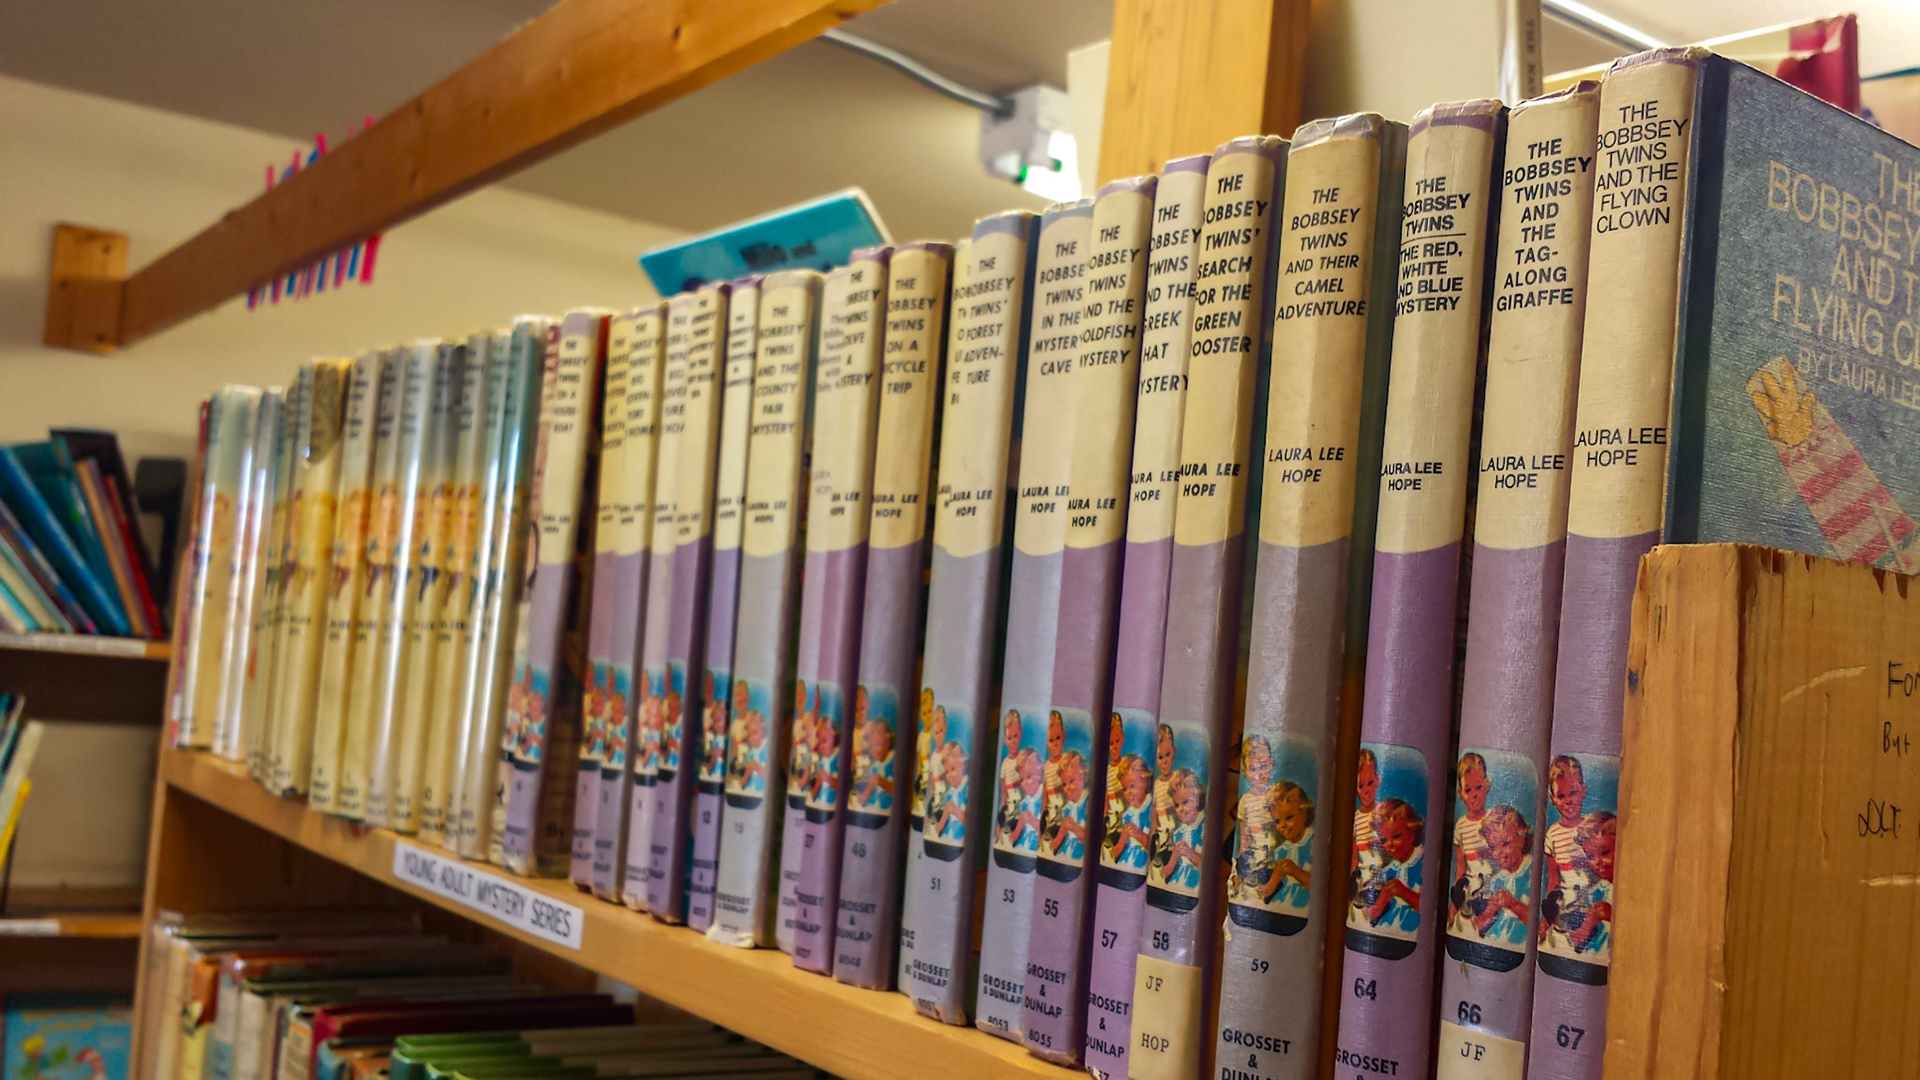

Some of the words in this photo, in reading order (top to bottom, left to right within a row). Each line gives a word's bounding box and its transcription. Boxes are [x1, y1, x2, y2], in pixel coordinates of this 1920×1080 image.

[1619, 100, 1658, 124] THE
[1597, 118, 1688, 151] BOBBSEY
[1528, 138, 1562, 159] THE
[1606, 142, 1667, 168] TWINS
[1504, 156, 1592, 186] BOBBSEY
[1596, 167, 1632, 192] AND
[1637, 162, 1678, 183] THE
[1217, 174, 1244, 195] THE
[1416, 177, 1446, 195] THE
[1514, 179, 1572, 204] TWINS
[1313, 187, 1340, 204] THE
[1601, 185, 1668, 212] FLYING
[1158, 204, 1180, 223] THE
[1292, 207, 1361, 231] BOBBSEY
[1521, 202, 1559, 223] AND
[1597, 206, 1670, 233] CLOWN
[1100, 225, 1120, 243] THE
[1405, 215, 1455, 237] TWINS
[1521, 223, 1556, 243] THE
[1150, 228, 1202, 252] OBBSEY
[1205, 228, 1260, 251] TWINS'
[1300, 232, 1348, 251] TWINS
[1056, 242, 1077, 257] THE
[1088, 248, 1140, 270] OBBSEY
[1400, 245, 1419, 265] THE
[1422, 241, 1462, 259] RED,
[1515, 245, 1558, 265] TAG-
[979, 256, 996, 273] THE
[1040, 264, 1085, 284] BOBBSE
[1149, 256, 1188, 278] TWINS
[1197, 256, 1252, 280] SEARCH
[1285, 258, 1313, 275] AND
[1319, 254, 1359, 270] THEIR
[1402, 261, 1448, 280] WHITE
[1089, 274, 1126, 294] TWINS
[1503, 266, 1567, 289] ALONG
[1831, 243, 1896, 306] AND
[896, 278, 916, 291] THE
[1167, 282, 1196, 299] THE
[1295, 278, 1344, 296] CAMEL
[1397, 282, 1414, 299] ND
[1418, 277, 1464, 293] BLUE
[1045, 287, 1083, 306] TWINS
[1196, 290, 1215, 307] OR
[1222, 284, 1252, 301] THE
[1497, 288, 1573, 312] GIRAFFE
[773, 306, 788, 318] THE
[888, 298, 936, 313] OBBSEY
[1083, 301, 1102, 319] ND
[1108, 299, 1134, 314] THE
[1276, 300, 1367, 321] ADVENTURE
[1773, 272, 1884, 357] FLYING
[889, 318, 924, 331] TWINS
[1042, 314, 1053, 330] IN
[1059, 311, 1080, 326] THE
[1194, 311, 1242, 332] GREEN
[966, 324, 1003, 342] FOREST
[1083, 325, 1136, 344] OLDFISH
[765, 344, 794, 356] TWINS
[909, 340, 918, 351] A
[1034, 335, 1082, 354] MYSTER
[1143, 343, 1168, 363] HAT
[1190, 336, 1251, 357] OOSTER
[1041, 359, 1072, 376] CAVE
[1080, 350, 1131, 368] YSTERY
[758, 365, 776, 377] AND
[781, 363, 799, 374] THE
[967, 370, 990, 385] TURE
[1799, 346, 1826, 378] BY
[1828, 354, 1888, 401] LAURA
[887, 382, 912, 395] TRIP
[1140, 374, 1188, 395] YSTERY
[763, 404, 783, 414] FAIR
[1628, 428, 1667, 445] LEE
[1269, 448, 1312, 463] LAURA
[1319, 447, 1345, 461] LEE
[1480, 456, 1526, 472] LAURA
[1532, 455, 1565, 470] LEE
[1587, 449, 1637, 467] HOPE
[1160, 471, 1180, 483] LEE
[1180, 463, 1207, 477] AURA
[1216, 463, 1240, 477] LEE
[1282, 469, 1322, 483] HOPE
[1415, 462, 1443, 475] LEE
[1183, 483, 1216, 497] HOPE
[1388, 478, 1422, 491] HOPE
[1494, 473, 1538, 489] HOPE
[901, 494, 919, 504] LEE
[976, 489, 992, 500] LEE
[1022, 486, 1049, 498] LAURA
[1134, 489, 1160, 502] HOPE
[876, 509, 901, 518] HOPE
[956, 506, 976, 517] HOPE
[1031, 502, 1056, 513] HOPE
[1097, 498, 1116, 510] LEE
[1072, 516, 1097, 527] HOPE
[931, 878, 941, 890] 51
[1003, 889, 1015, 903] 53
[477, 879, 527, 918] MYSTERY
[531, 897, 571, 938] SERIES
[1044, 898, 1059, 918] 55
[1101, 929, 1118, 949] 57
[1153, 930, 1170, 951] 58
[913, 959, 950, 978] GROSSET
[1027, 962, 1066, 985] GROSSET
[1251, 958, 1269, 974] 59
[983, 974, 1024, 994] GROSSET
[1146, 975, 1163, 992] JF
[1354, 977, 1377, 1000] 64
[989, 987, 1022, 1005] DUNLAP
[1025, 996, 1062, 1018] DUNLAP
[1458, 1001, 1482, 1025] 66
[1099, 1017, 1106, 1031] &
[1029, 1029, 1052, 1048] 8055
[1141, 1033, 1169, 1052] HOP
[1223, 1028, 1291, 1055] GROSSET
[1557, 1024, 1584, 1049] 67
[1248, 1053, 1258, 1069] &
[1461, 1042, 1486, 1061] JF
[1336, 1047, 1399, 1076] GROSSET
